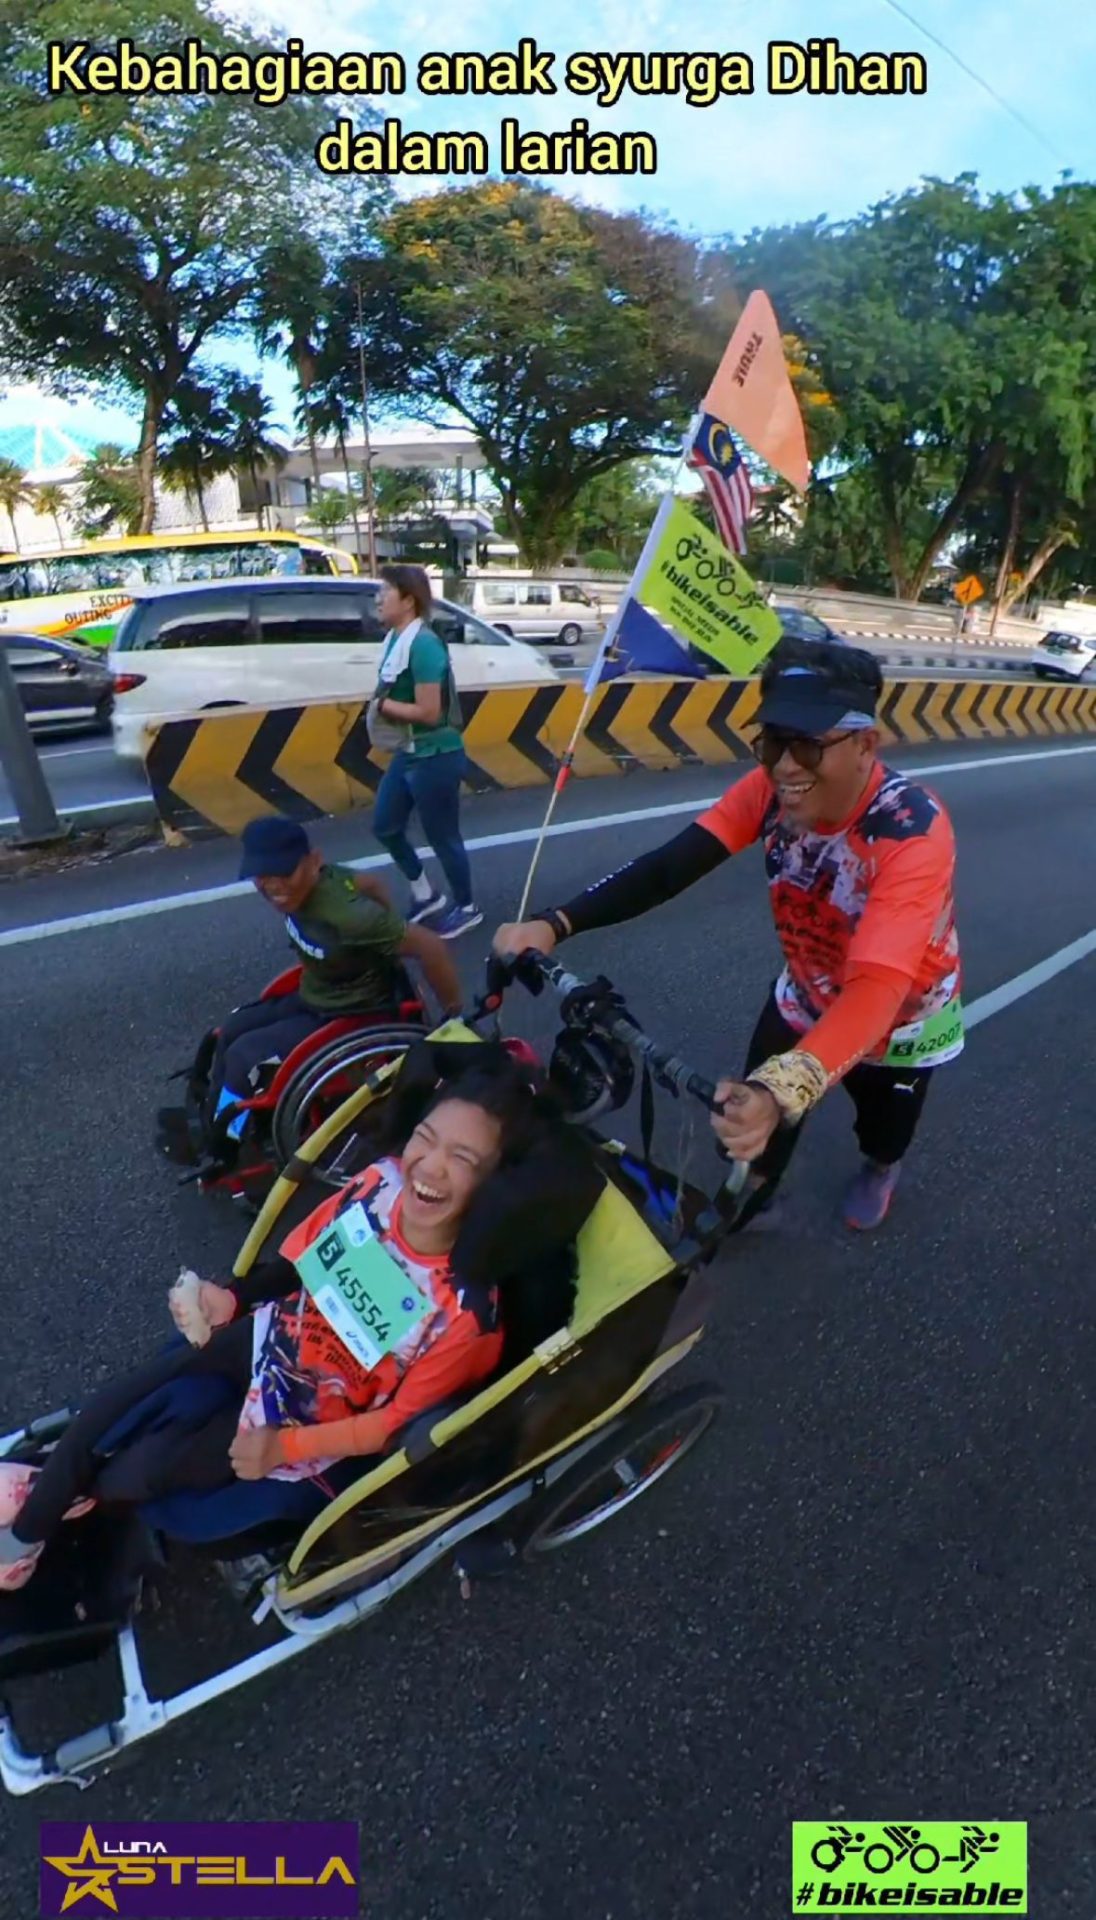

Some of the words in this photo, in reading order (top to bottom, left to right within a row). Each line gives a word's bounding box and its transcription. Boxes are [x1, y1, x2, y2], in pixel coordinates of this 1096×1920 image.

[64, 608, 113, 625] OUTING
[916, 1021, 961, 1053] 42007
[336, 1267, 392, 1343] 45554
